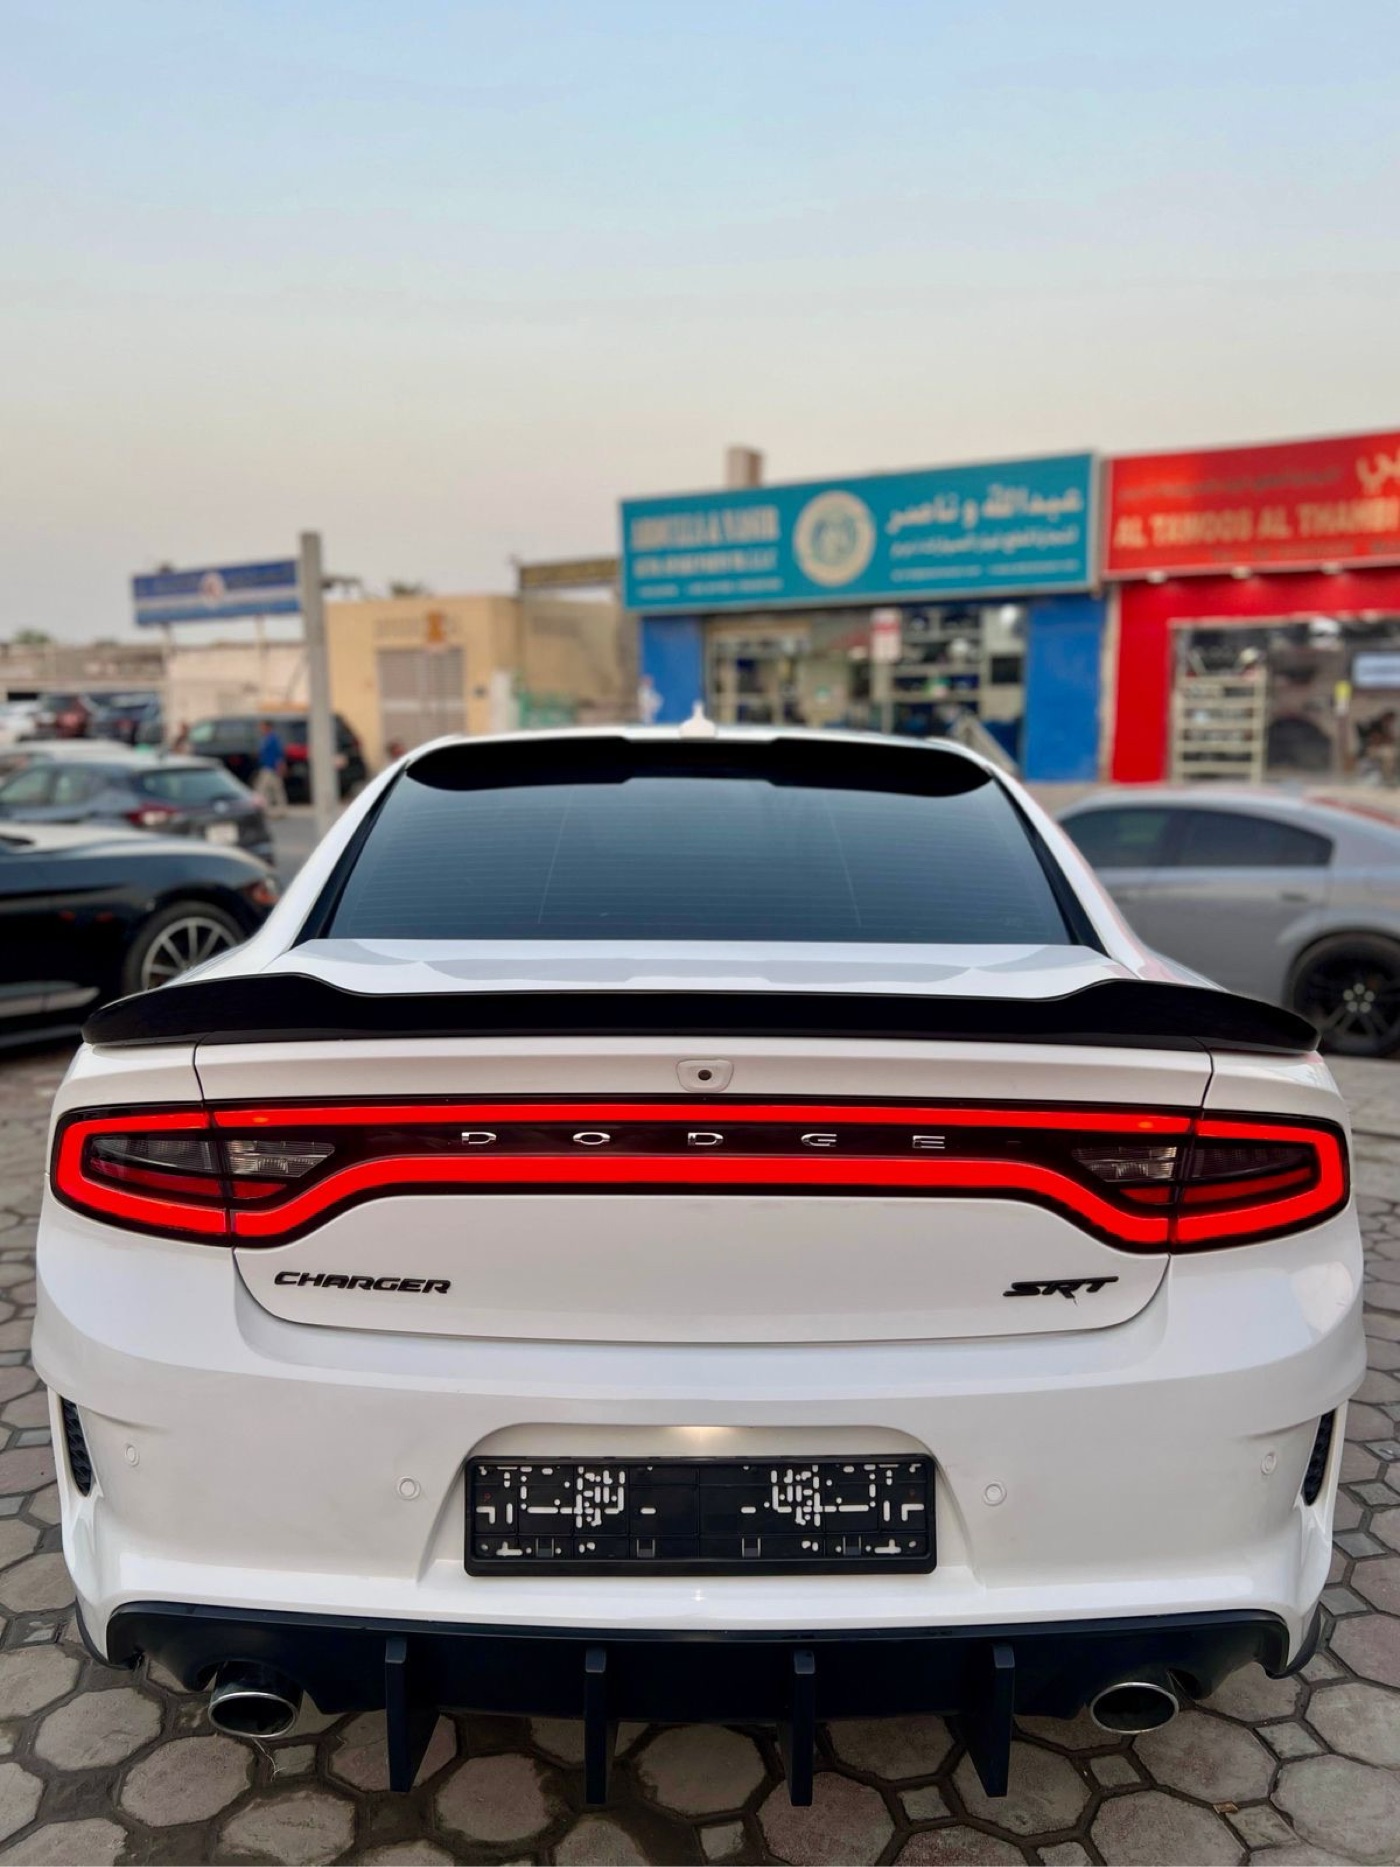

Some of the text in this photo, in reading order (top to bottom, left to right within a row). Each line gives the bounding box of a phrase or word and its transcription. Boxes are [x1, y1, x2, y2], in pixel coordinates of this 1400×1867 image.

[461, 1130, 946, 1150] DODGE
[273, 1270, 452, 1295] CHARGER
[1002, 1275, 1120, 1302] SRT
